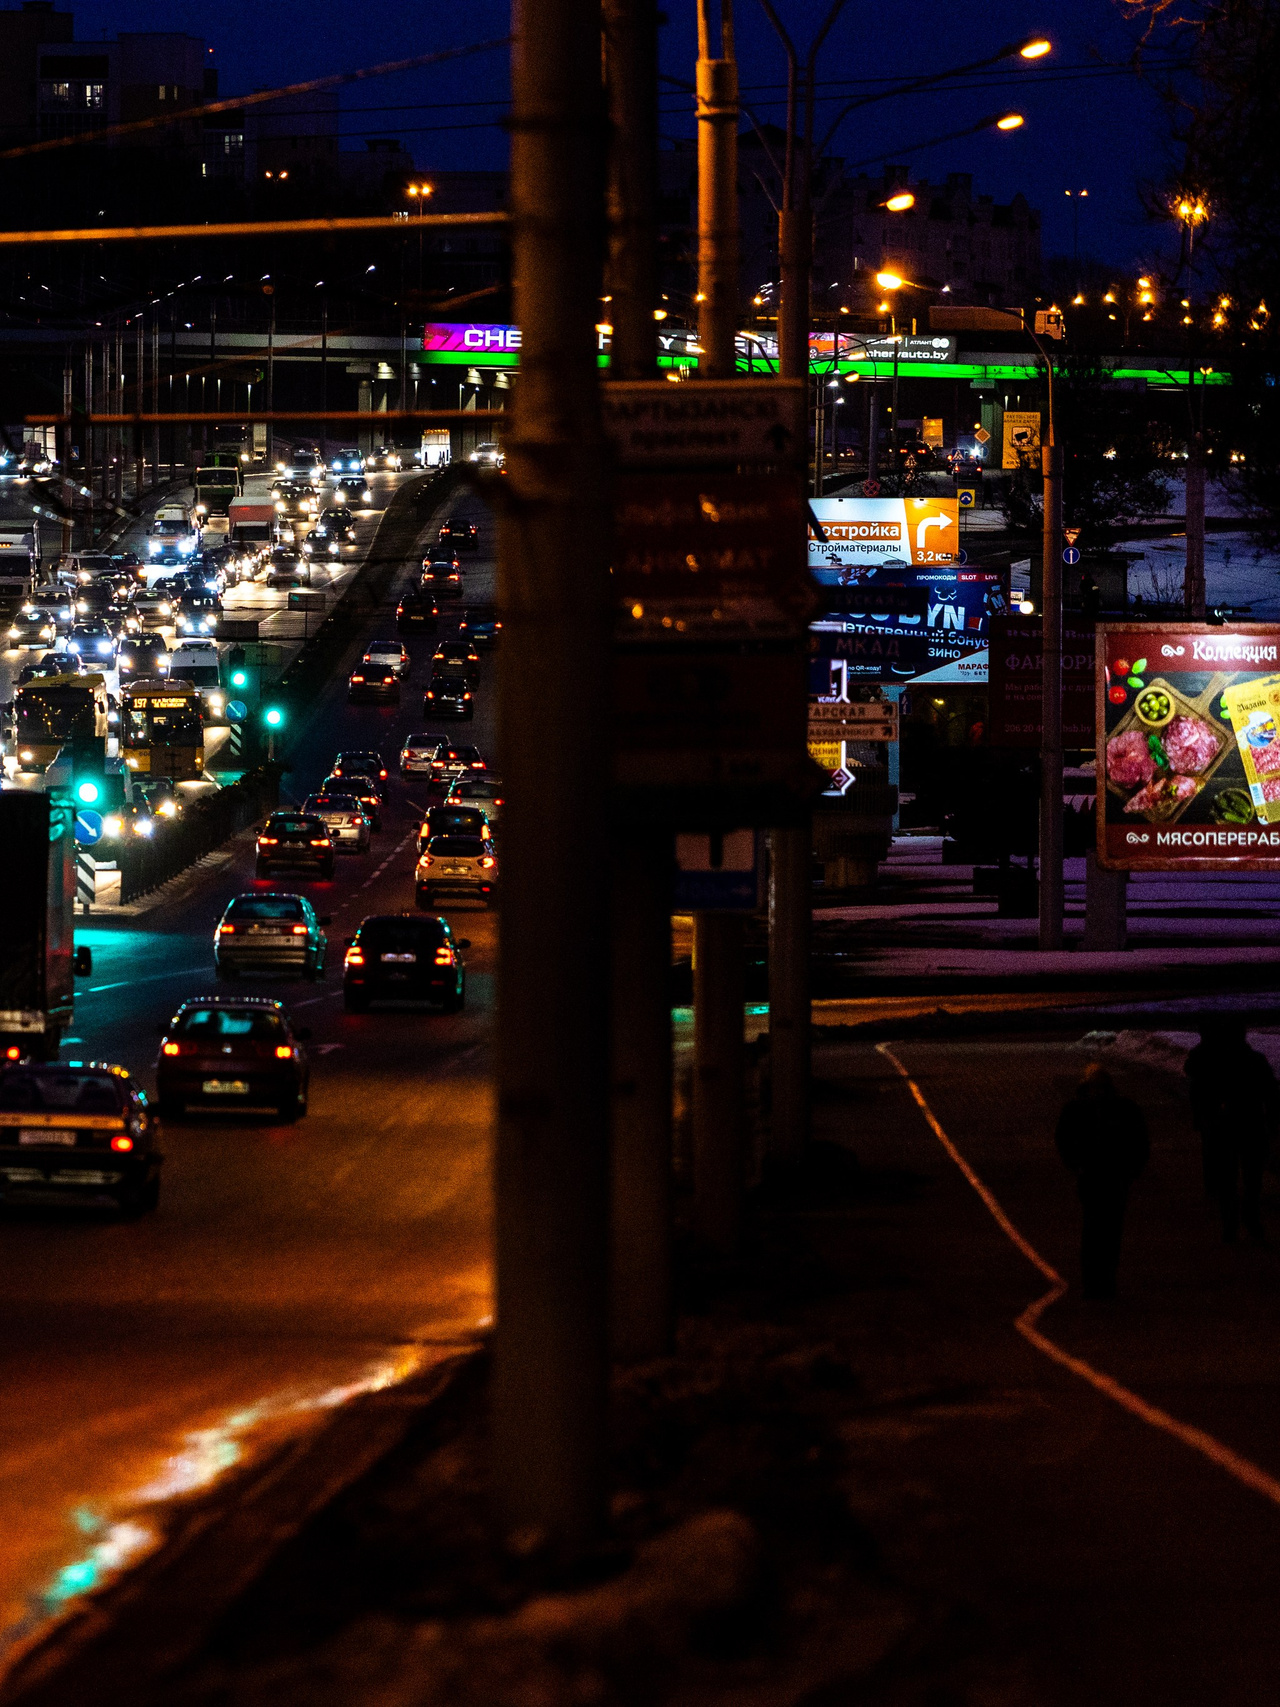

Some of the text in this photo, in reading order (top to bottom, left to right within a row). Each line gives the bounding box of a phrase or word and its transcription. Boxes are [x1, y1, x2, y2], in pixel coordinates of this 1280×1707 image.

[808, 543, 902, 555] Стройматериалы
[917, 551, 934, 562] 3,2
[835, 638, 901, 657] МКАД
[948, 631, 989, 650] бонус
[1192, 640, 1278, 663] Коллекция
[133, 698, 148, 709] 197
